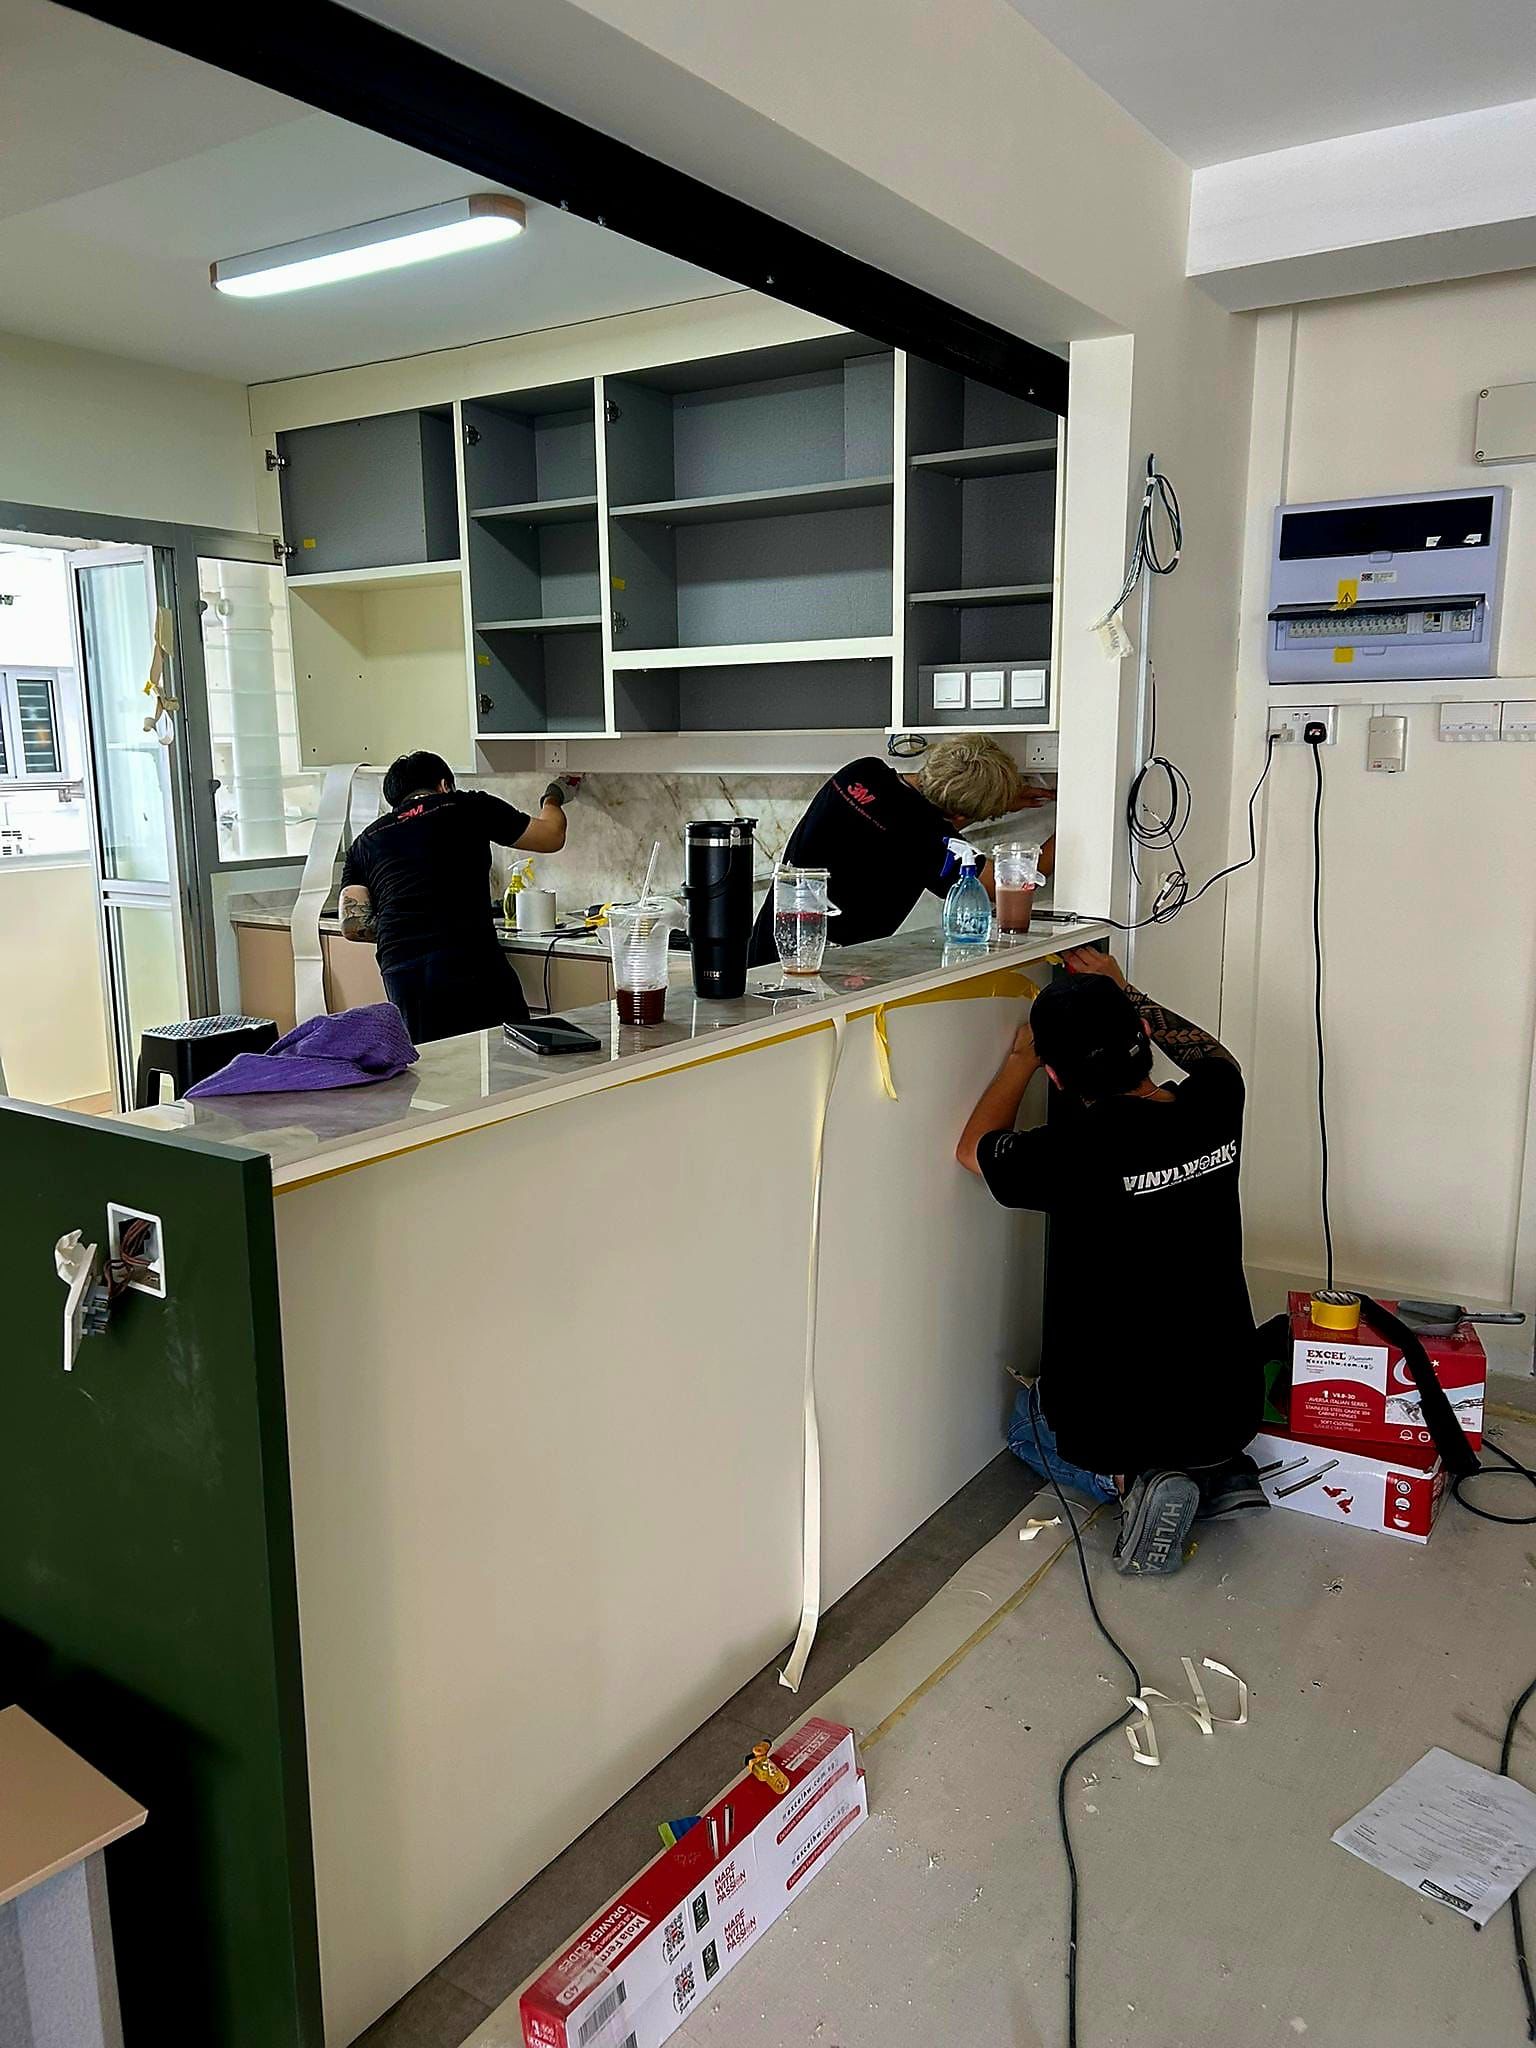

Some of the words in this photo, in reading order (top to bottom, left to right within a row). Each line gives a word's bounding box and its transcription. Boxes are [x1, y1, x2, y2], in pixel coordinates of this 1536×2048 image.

[847, 782, 876, 805] 3M
[1122, 1139, 1237, 1192] VINYLWORKS
[1307, 1349, 1346, 1360] EXCEL
[1330, 1398, 1350, 1406] ITALIAN
[714, 1861, 736, 1887] MADE
[715, 1872, 735, 1894] WITH
[717, 1869, 746, 1904] PASSION
[587, 1905, 627, 1943] DRAWER
[620, 1919, 645, 1940] Mola
[724, 1908, 745, 1935] MADE
[725, 1919, 745, 1942] WITH
[727, 1916, 756, 1952] PASSION
[559, 1941, 591, 1972] SLIDES
